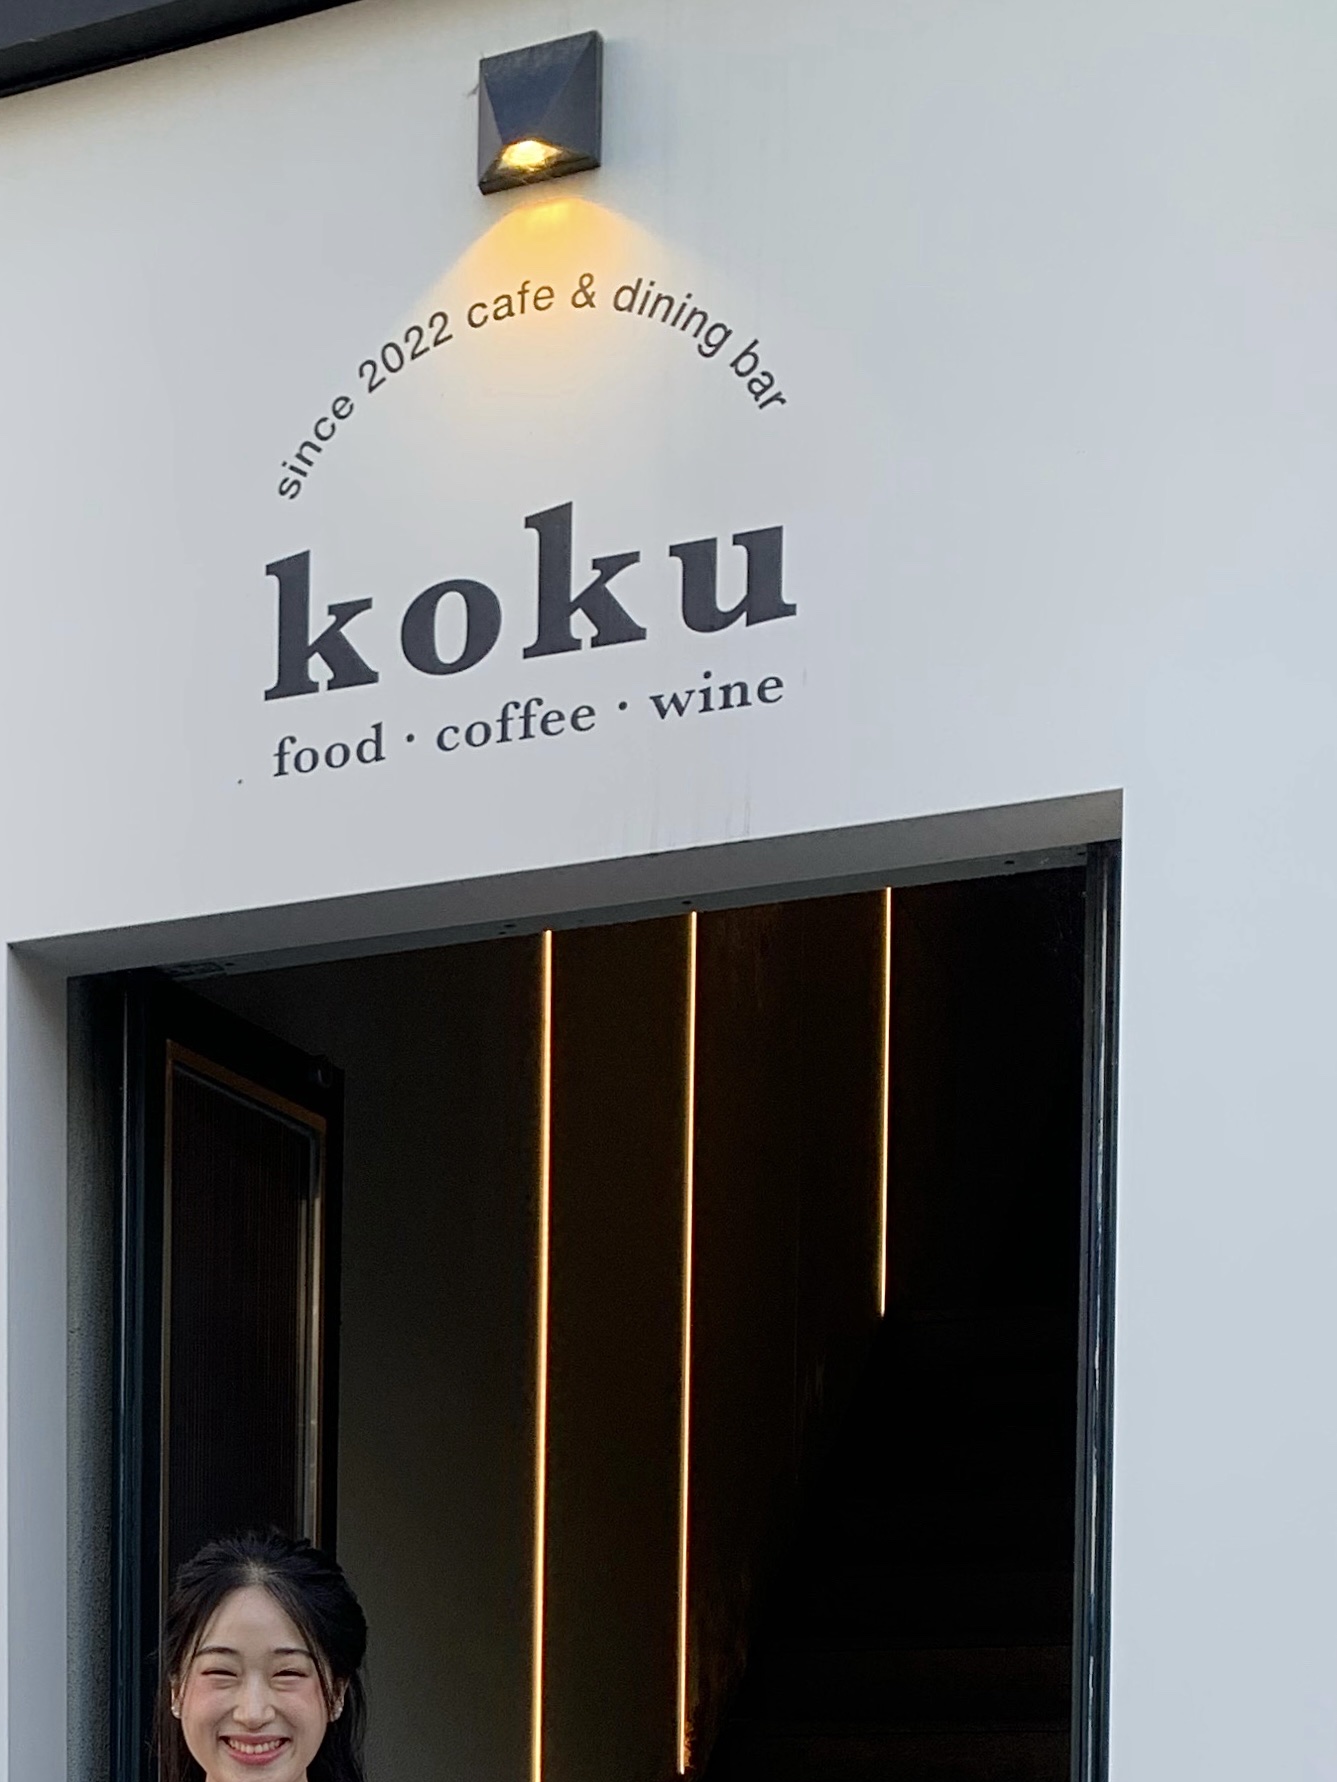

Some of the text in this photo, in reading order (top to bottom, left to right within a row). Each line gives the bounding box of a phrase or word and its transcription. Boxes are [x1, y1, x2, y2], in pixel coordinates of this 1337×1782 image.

[277, 272, 787, 500] since 2022 cafe & dining bar
[263, 501, 797, 702] koku
[272, 670, 785, 778] food coffee wine
